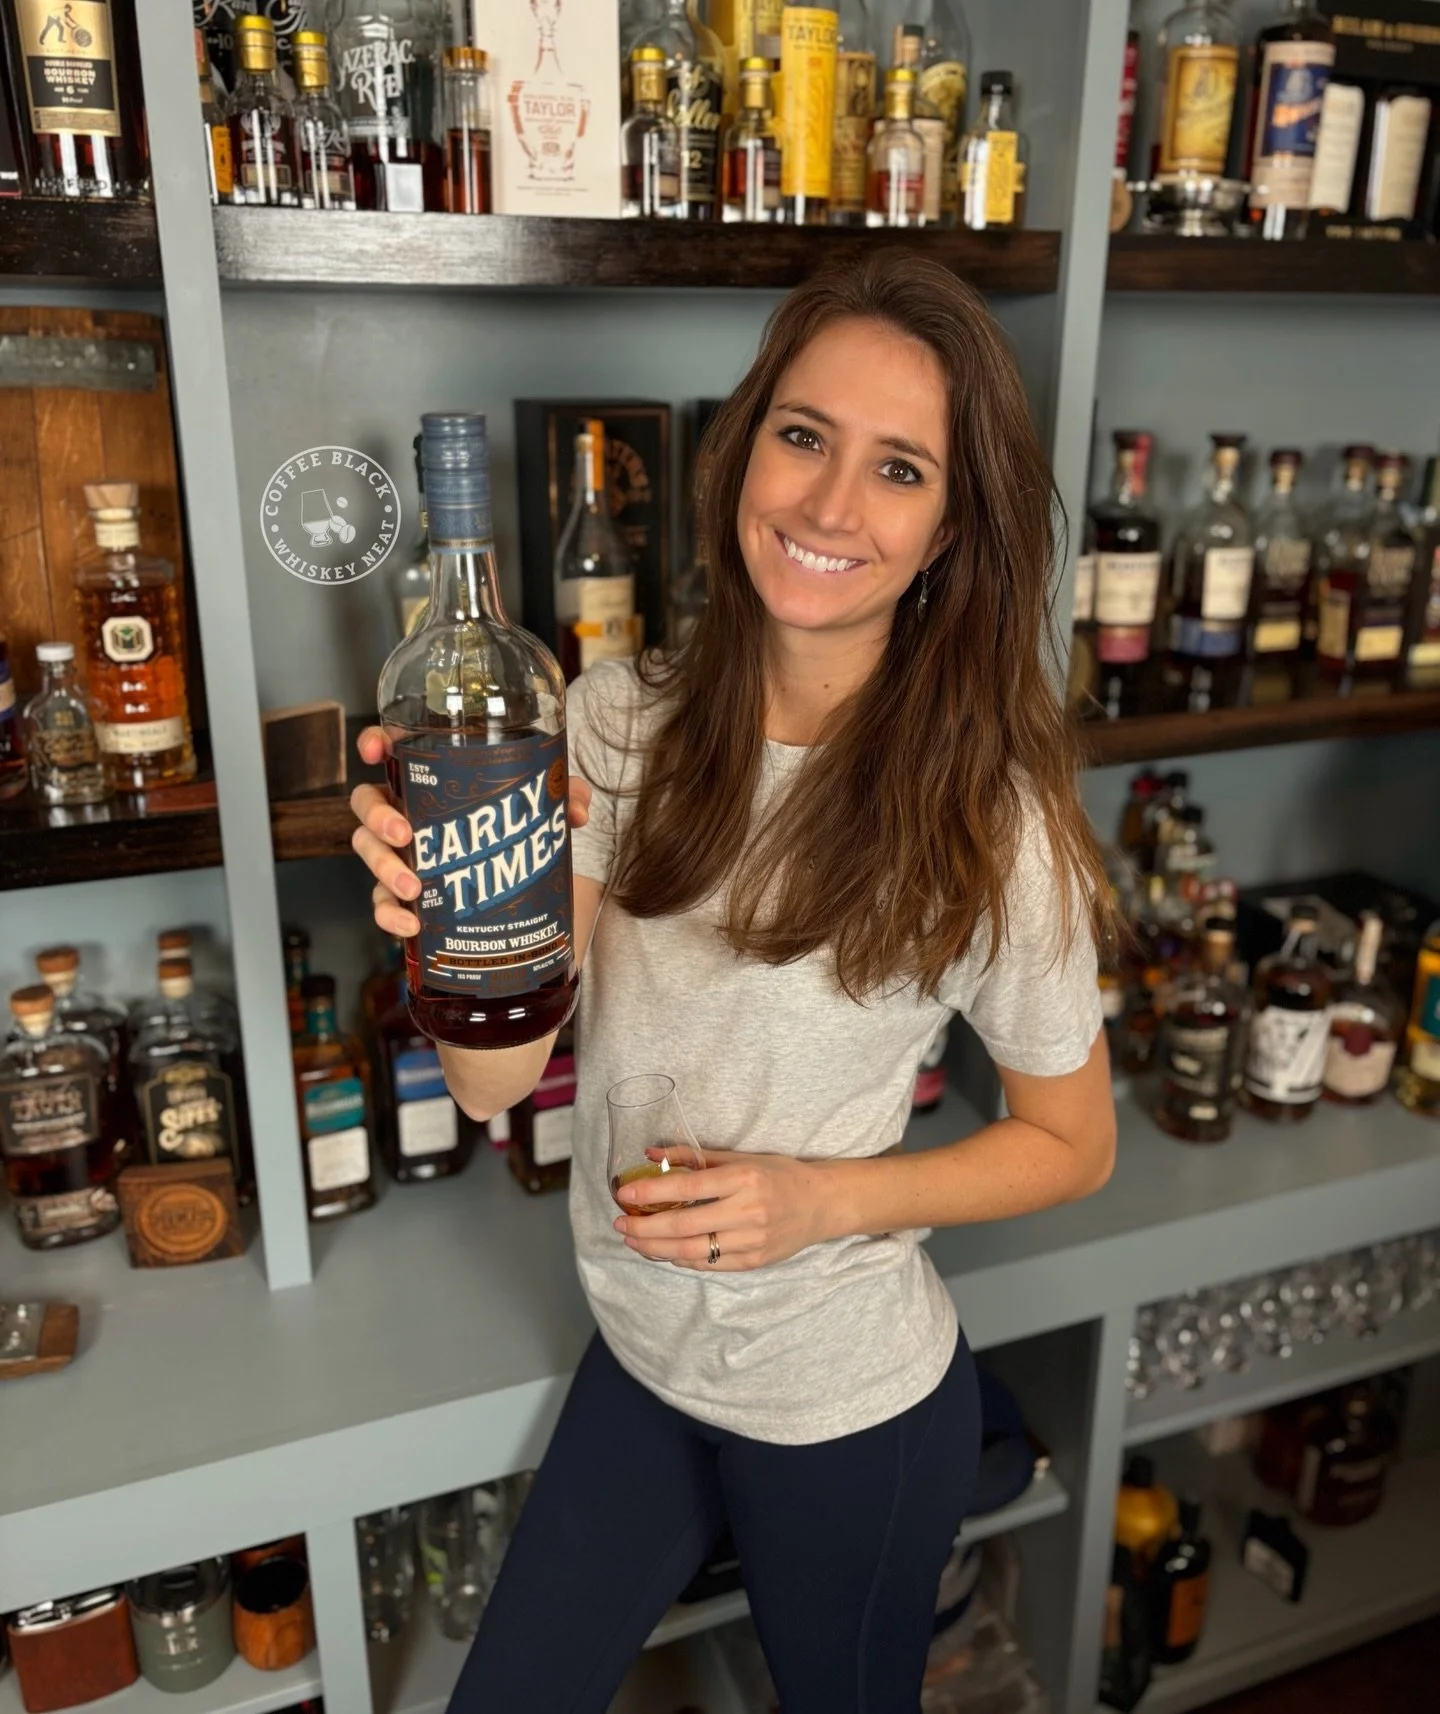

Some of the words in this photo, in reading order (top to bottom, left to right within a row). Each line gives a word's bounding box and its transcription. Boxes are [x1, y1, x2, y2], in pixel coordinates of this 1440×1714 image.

[44, 68, 96, 79] BOURBON
[524, 100, 576, 117] TAYLOR
[410, 772, 438, 786] 1860
[413, 769, 547, 872] EARLY
[443, 801, 568, 912] TIMES
[422, 896, 443, 909] STYLE
[423, 888, 438, 899] OLD
[456, 925, 505, 934] KENTUCKY
[507, 913, 549, 930] STRAIGHT
[444, 937, 507, 951] BOURBON
[508, 921, 559, 948] WHISKEY
[450, 941, 558, 967] BOTTLED-IN-BOND
